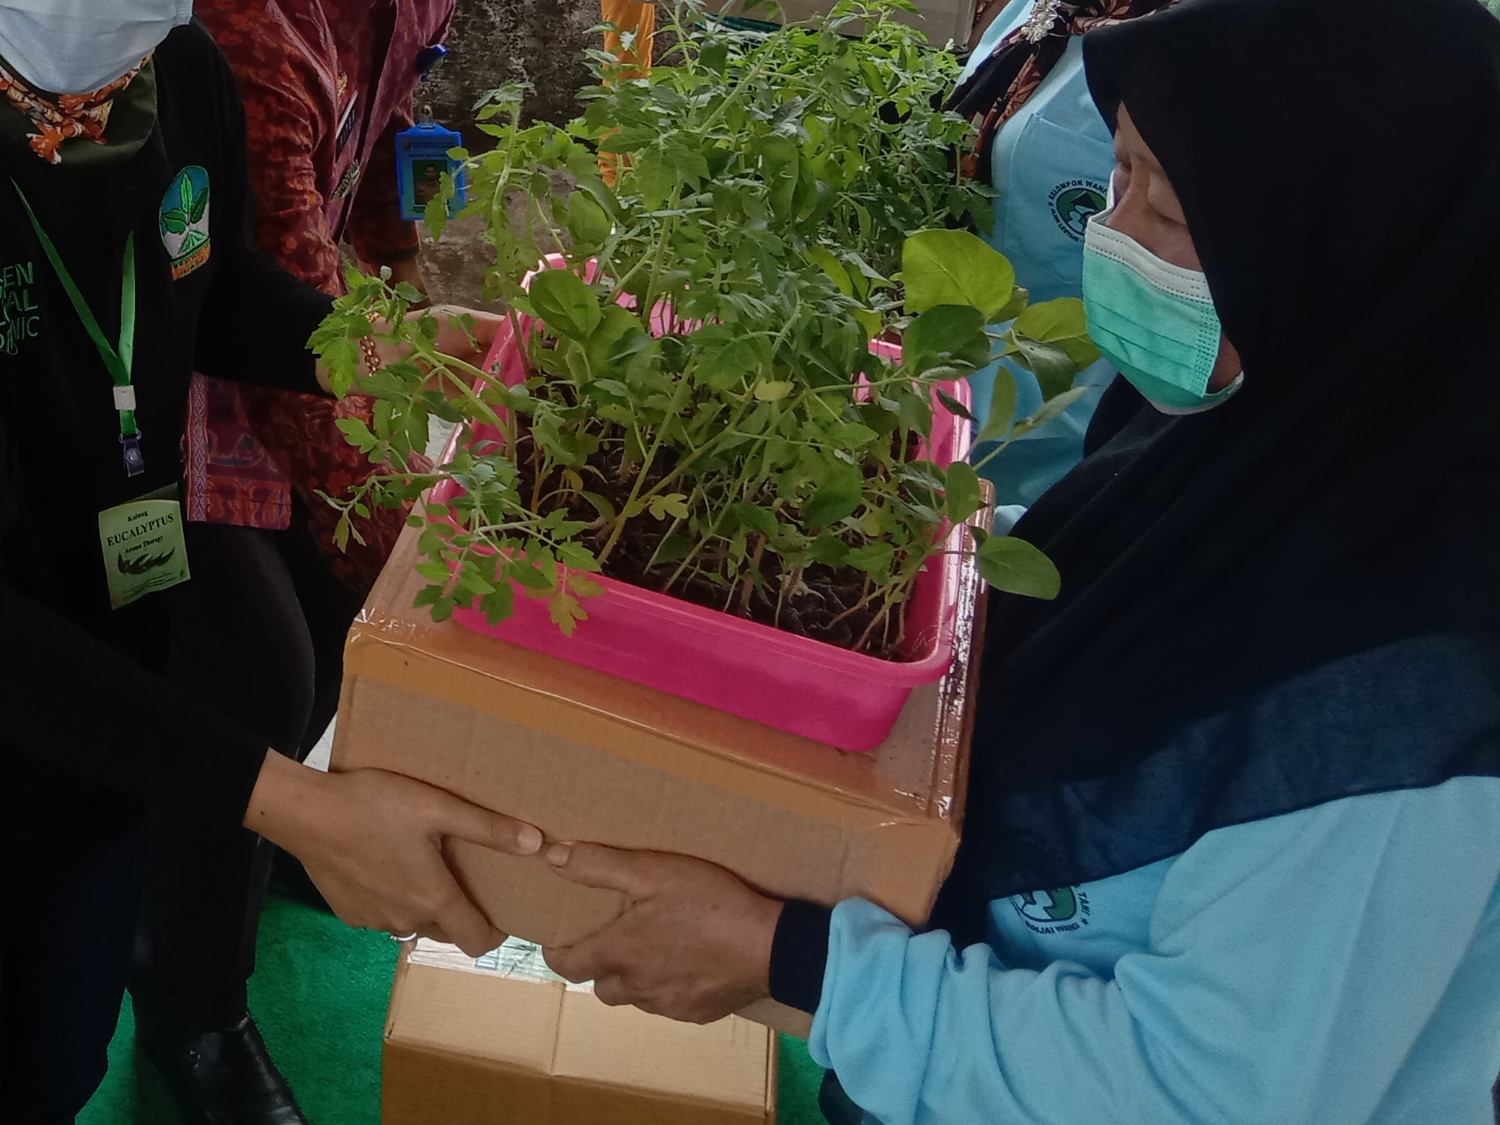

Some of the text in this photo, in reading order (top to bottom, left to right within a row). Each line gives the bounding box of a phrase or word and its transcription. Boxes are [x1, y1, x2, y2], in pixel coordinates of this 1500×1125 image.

[1048, 179, 1108, 201] KELOMPOK WANI
[106, 513, 175, 547] EUCALYPTUS
[1077, 891, 1090, 916] TANI
